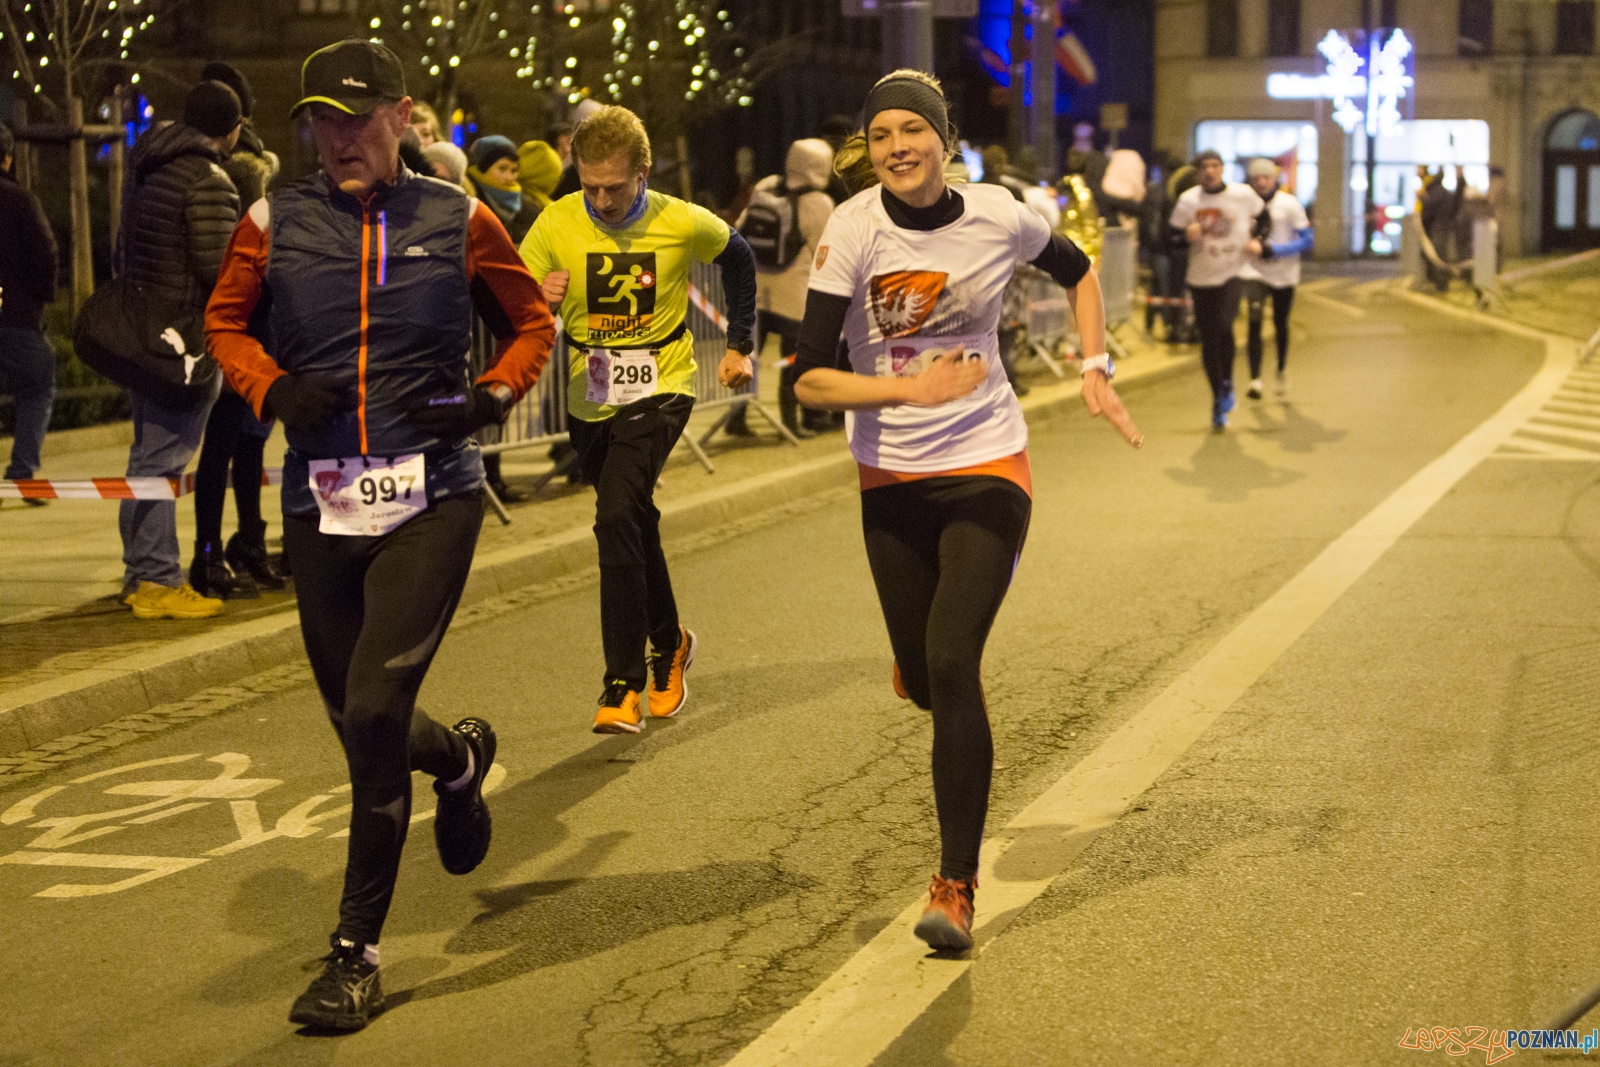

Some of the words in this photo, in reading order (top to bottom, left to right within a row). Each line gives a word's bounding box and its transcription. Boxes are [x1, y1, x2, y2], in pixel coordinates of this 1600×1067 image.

[601, 315, 642, 329] night
[588, 327, 651, 340] runners
[613, 364, 652, 385] 298
[359, 475, 417, 506] 997
